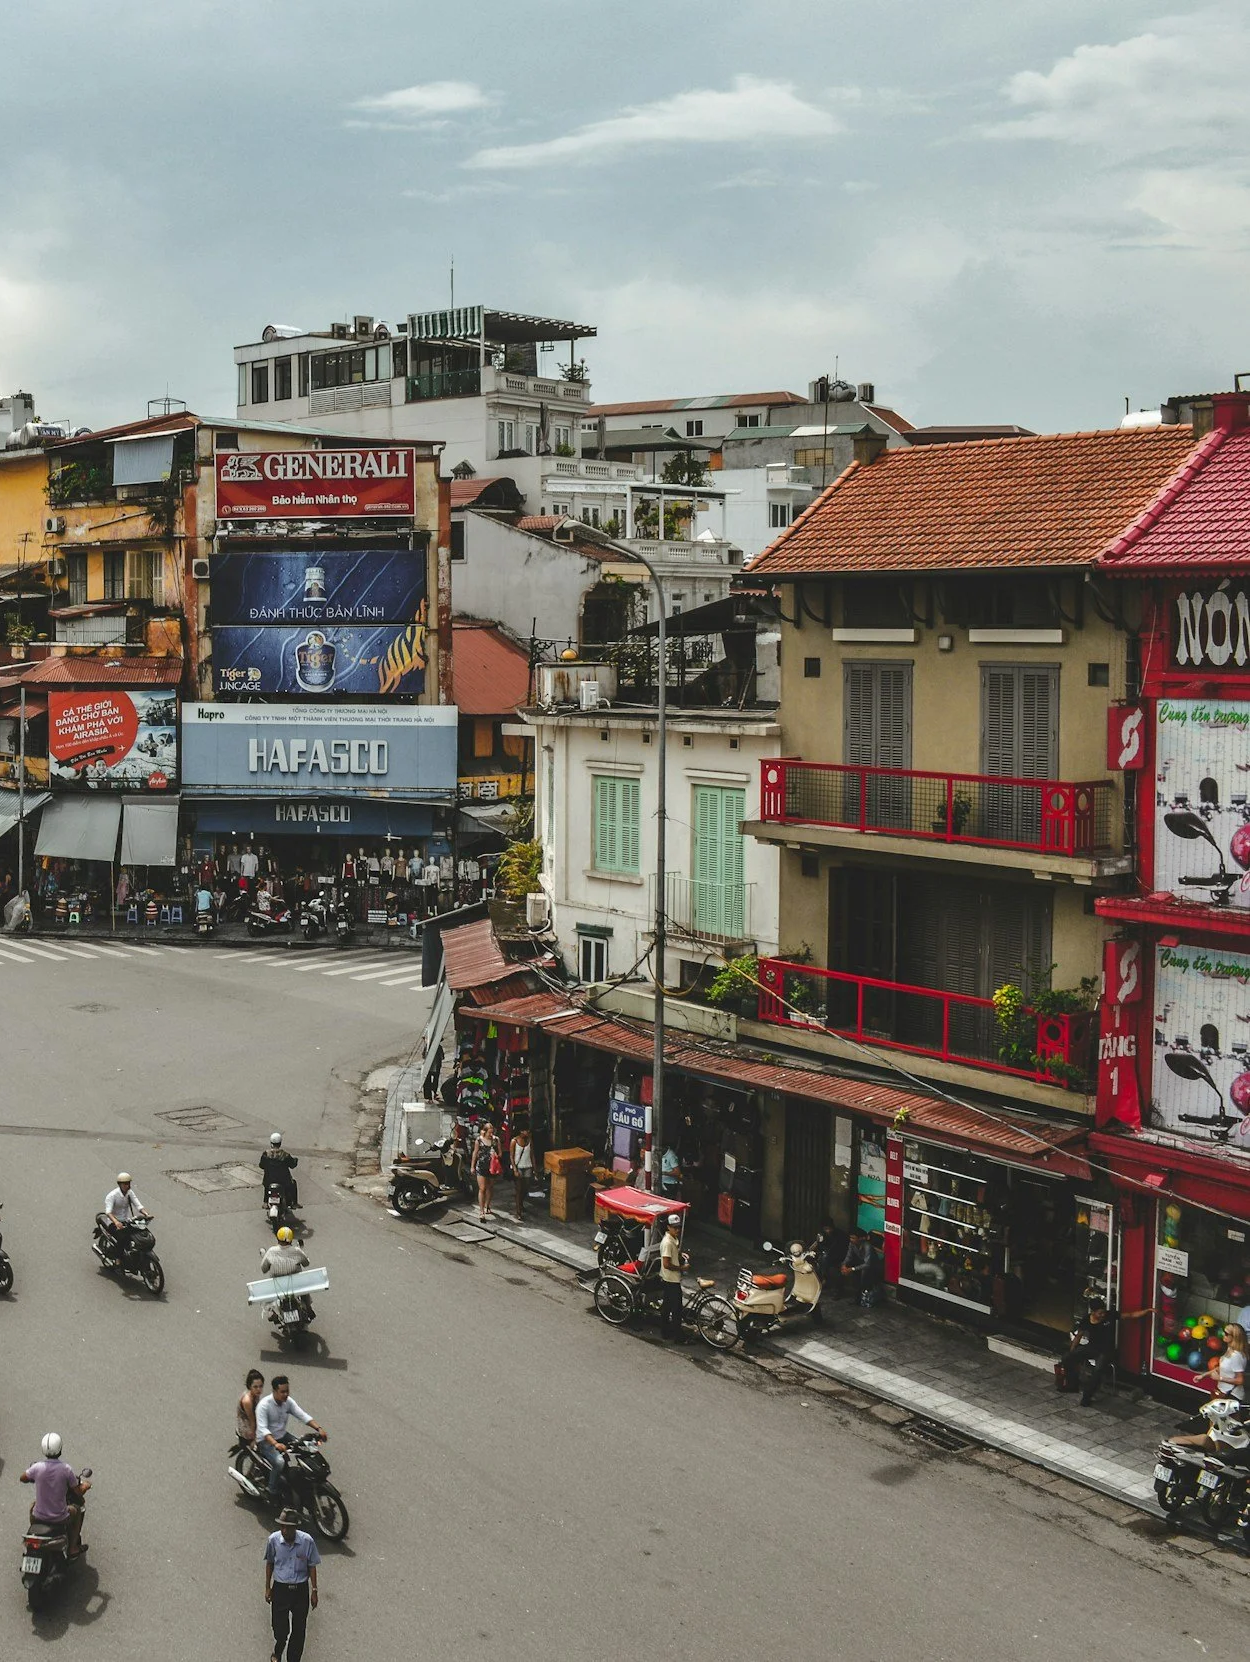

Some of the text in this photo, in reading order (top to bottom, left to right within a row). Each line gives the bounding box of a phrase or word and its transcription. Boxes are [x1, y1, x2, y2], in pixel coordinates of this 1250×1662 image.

[263, 451, 408, 480] GENERALI
[272, 492, 358, 506] Bảo hiểm Nhân thọ
[250, 604, 385, 619] ĐÁNH THỨC BẢN LĨNH
[299, 650, 334, 669] Tiger
[220, 668, 246, 681] Tiger
[219, 681, 261, 691] UNCAGE
[197, 708, 225, 720] Hapro
[1158, 702, 1188, 727] Cùng
[1191, 704, 1210, 722] đến
[73, 727, 109, 740] AIRASIA
[249, 738, 388, 774] HAFASCO
[275, 804, 351, 823] HAFASCO
[1160, 948, 1189, 974] Cùng
[1193, 955, 1212, 973] đến
[1110, 1067, 1119, 1096] 1
